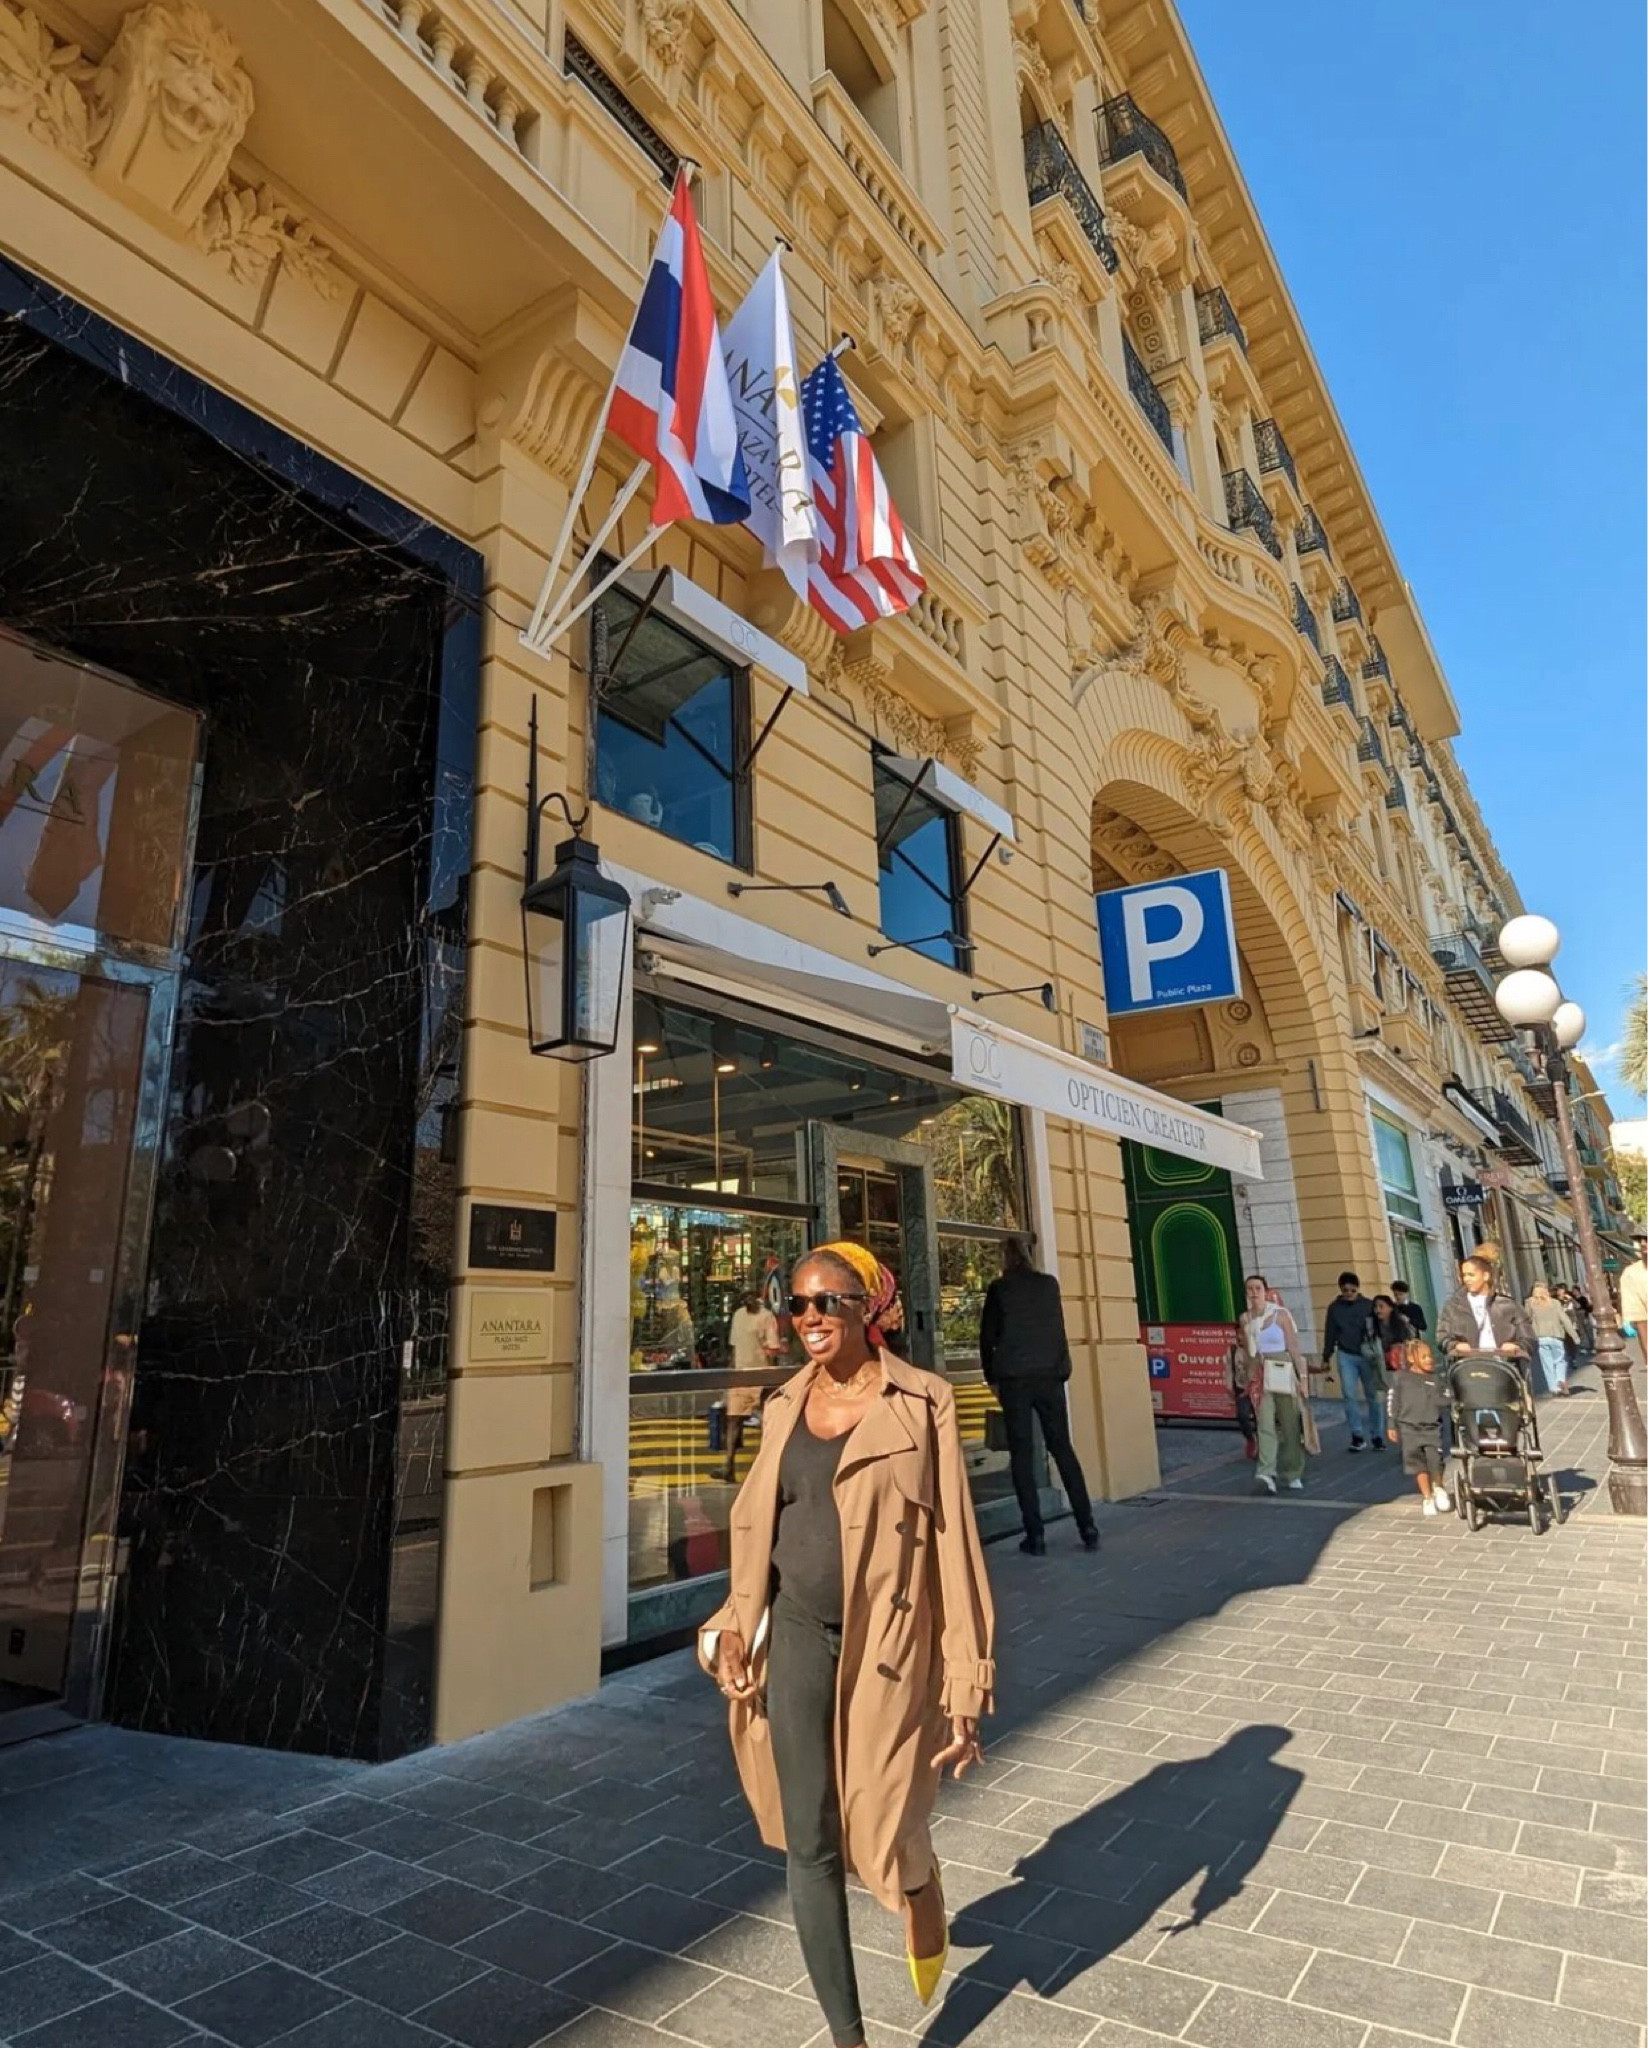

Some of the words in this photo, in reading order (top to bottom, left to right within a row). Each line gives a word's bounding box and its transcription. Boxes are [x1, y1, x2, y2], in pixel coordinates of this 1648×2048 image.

[0, 758, 84, 815] RA
[1122, 886, 1204, 1003] P
[1156, 988, 1185, 999] Public
[1187, 982, 1212, 995] Plaza
[1067, 1077, 1141, 1127] OPTICIEN
[1143, 1107, 1206, 1151] CREATEUR
[1445, 1194, 1483, 1204] OMEGA
[480, 1319, 541, 1333] ANANTARA
[1152, 1358, 1165, 1375] P
